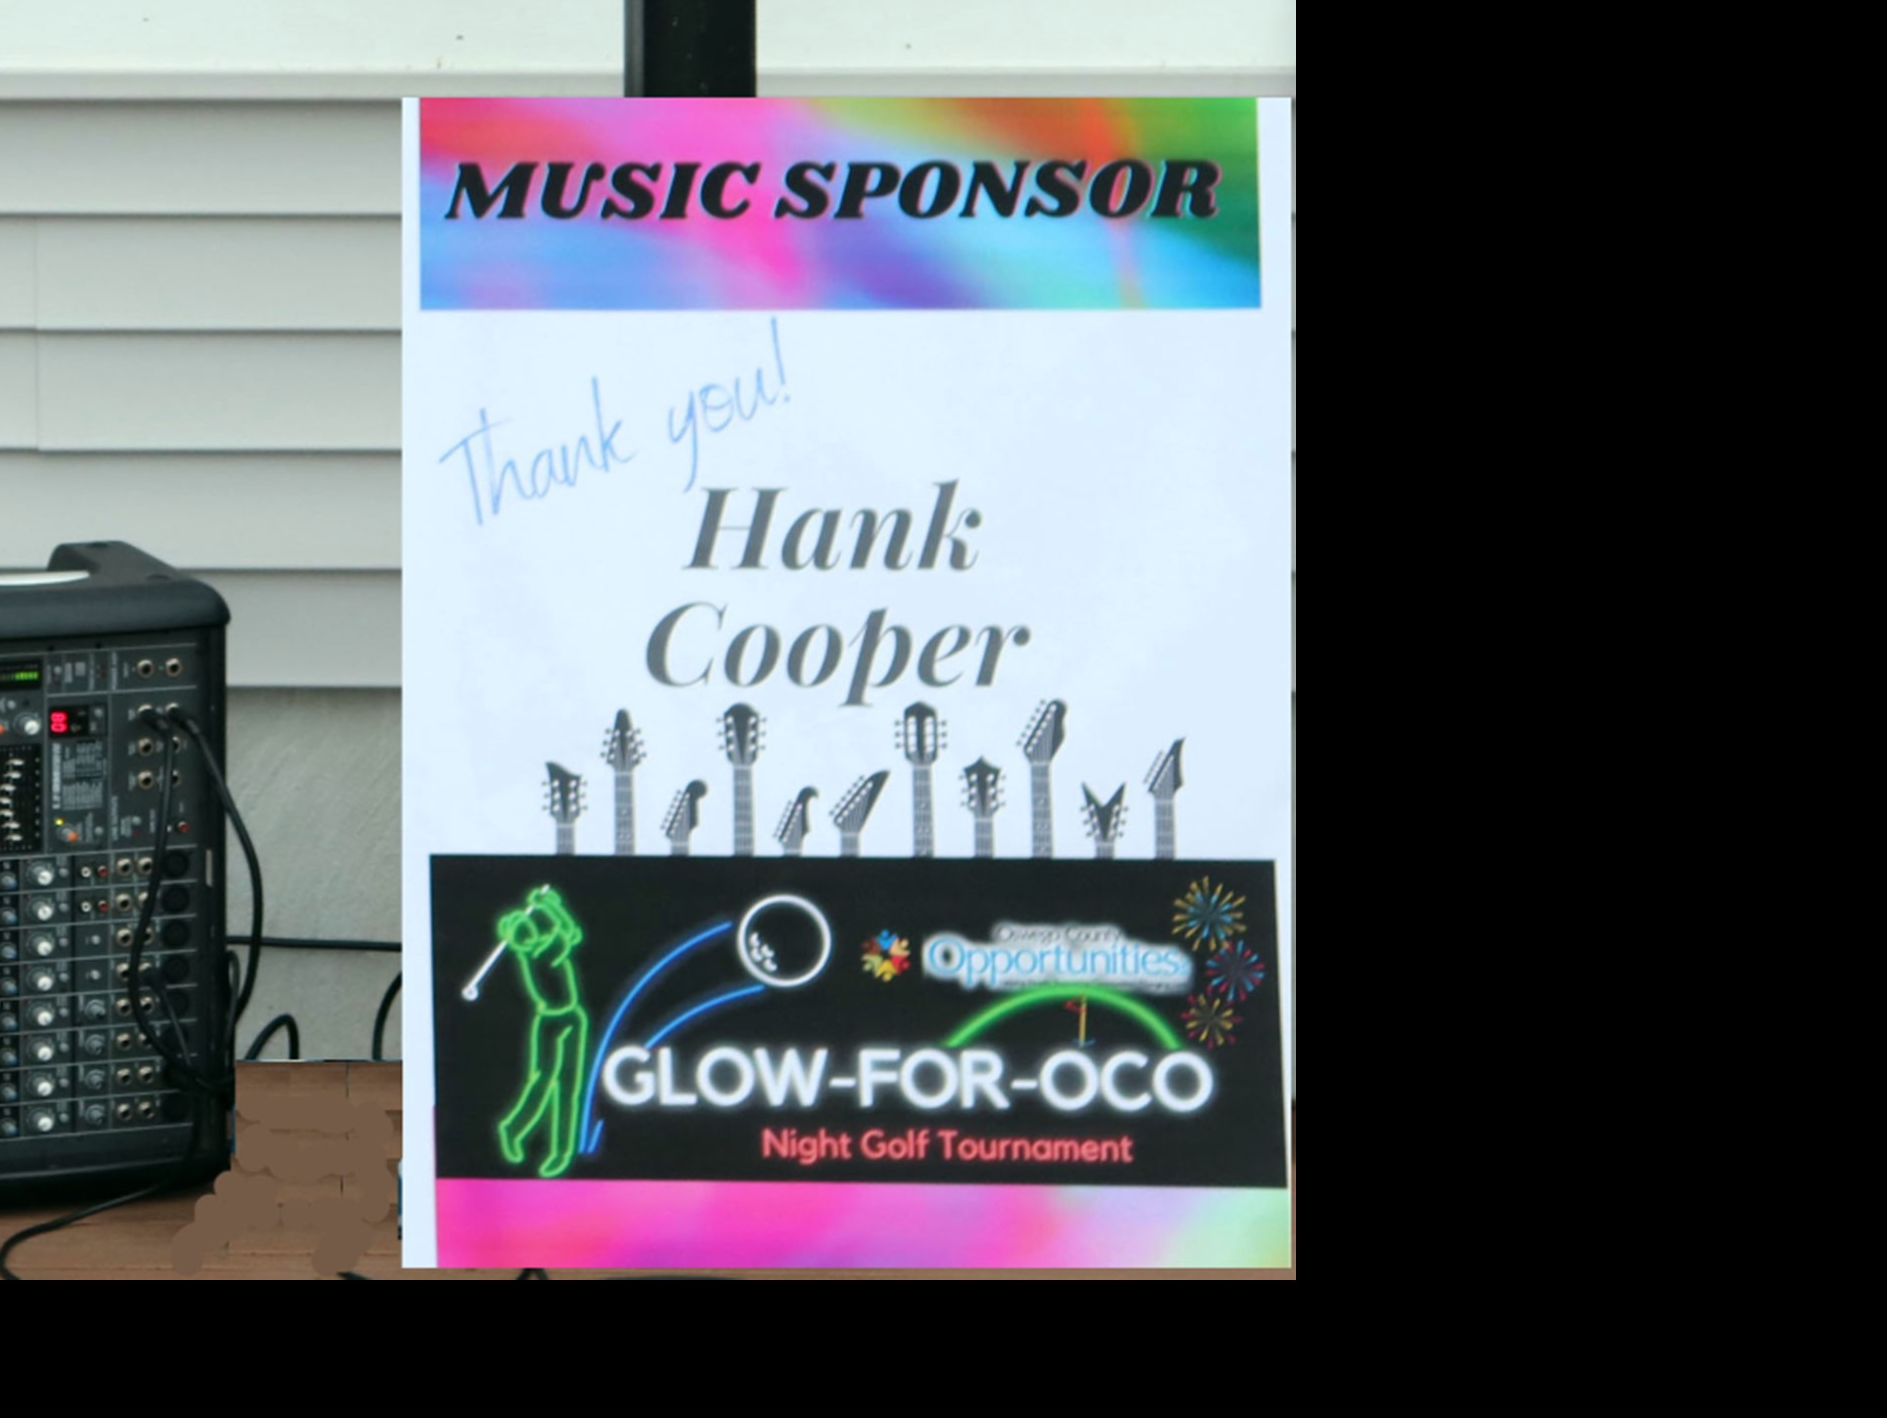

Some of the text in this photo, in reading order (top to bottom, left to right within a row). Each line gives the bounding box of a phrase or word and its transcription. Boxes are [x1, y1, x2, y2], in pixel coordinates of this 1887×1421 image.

[443, 159, 1222, 220] MUSIC SPONSOR
[439, 316, 791, 525] Thank you!
[681, 478, 982, 571] Hank
[645, 601, 1032, 708] Cooper
[928, 935, 1178, 988] Opportunities
[602, 1047, 1215, 1111] GLOW-FOR-OCO
[761, 1129, 1134, 1165] Night Golf Tournament
